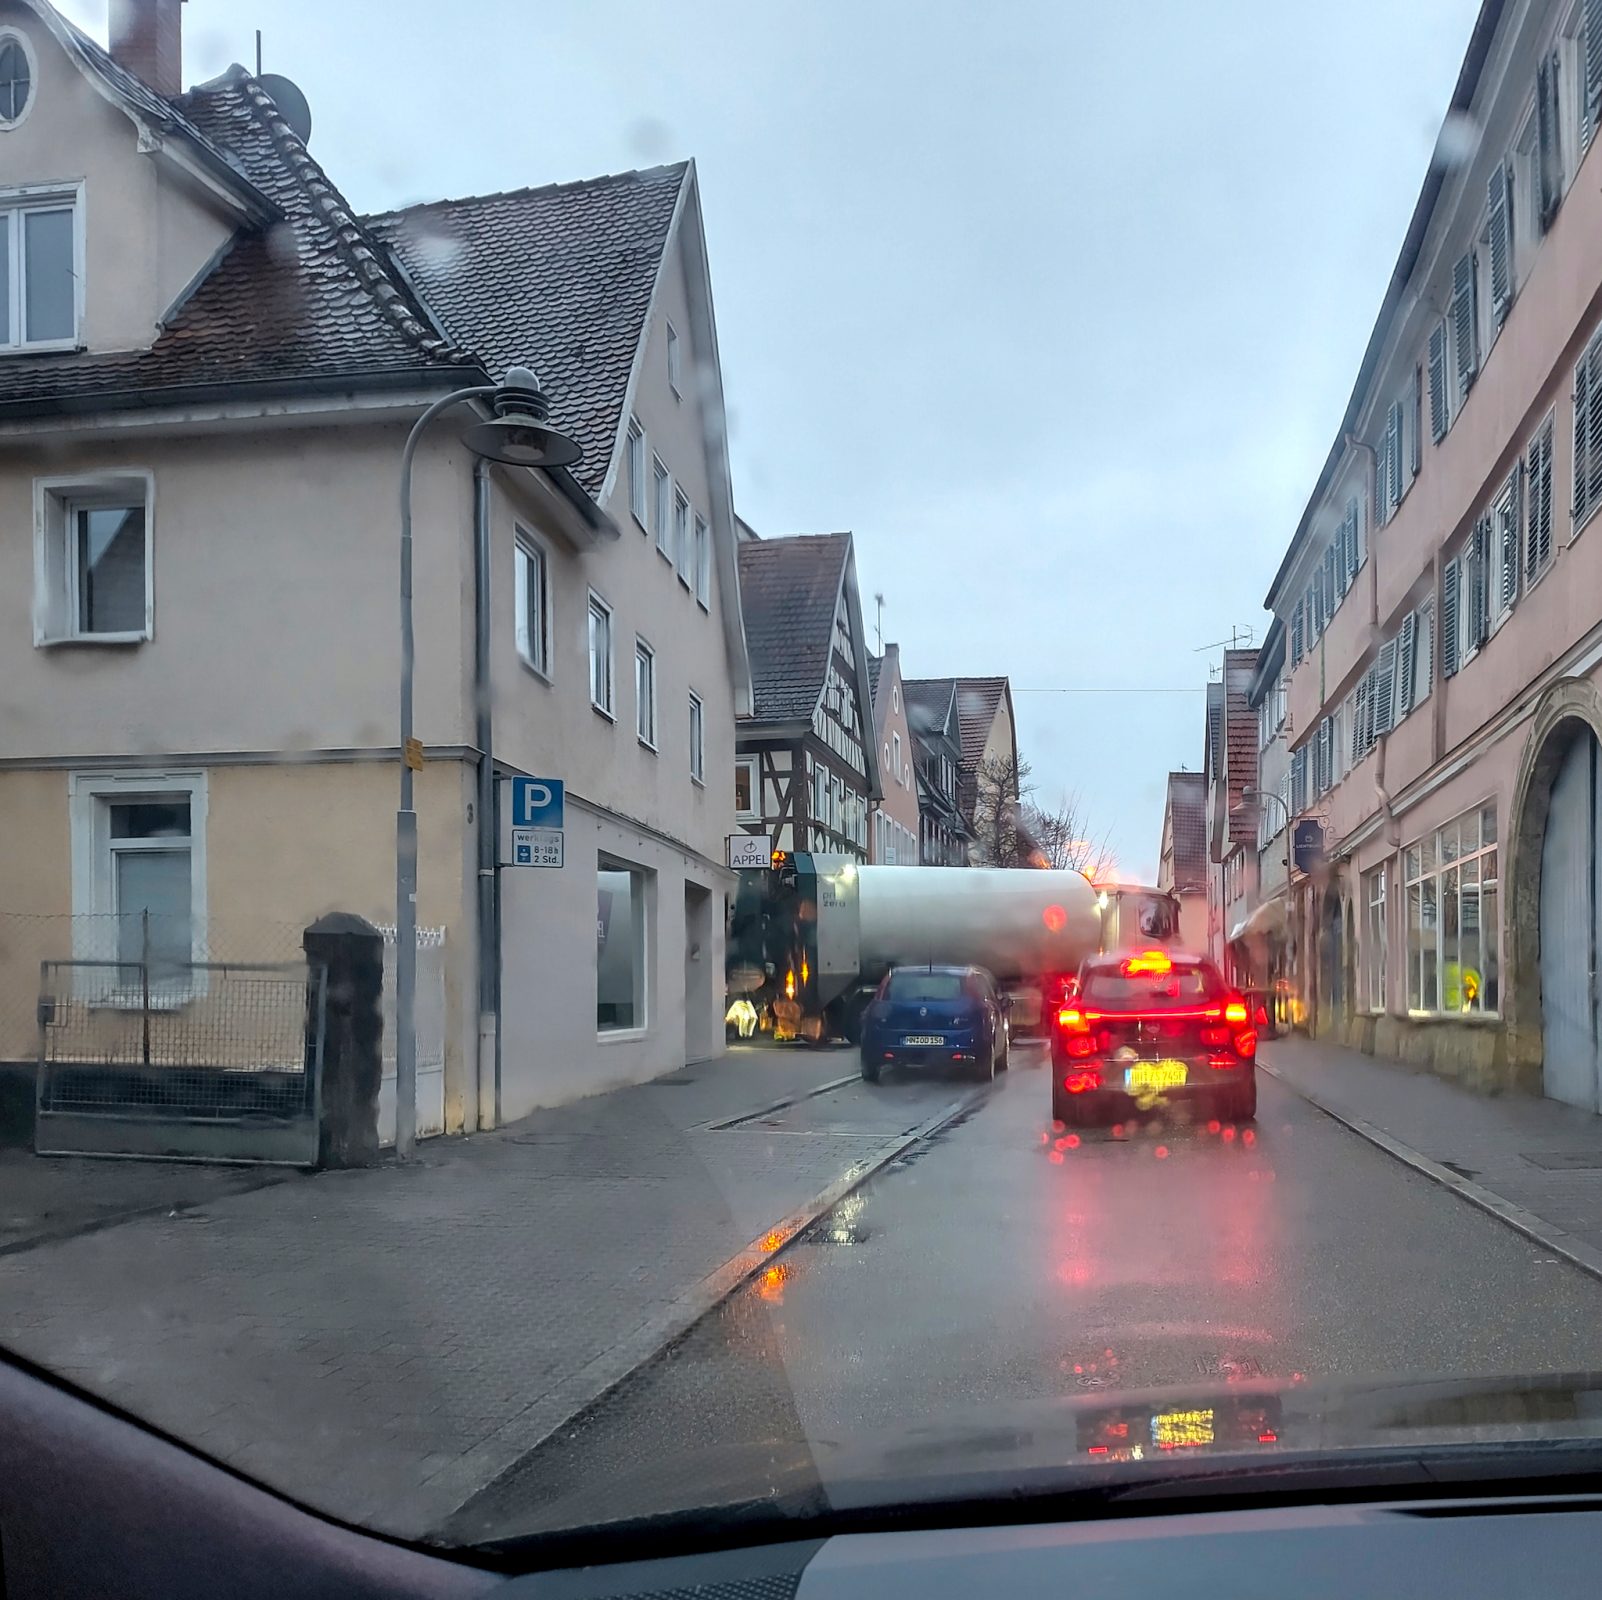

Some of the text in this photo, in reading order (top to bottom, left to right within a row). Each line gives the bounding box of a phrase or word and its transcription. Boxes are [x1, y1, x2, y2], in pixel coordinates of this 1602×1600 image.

[524, 783, 552, 820] P
[517, 834, 560, 844] werkgs
[534, 855, 560, 864] 2 Std.
[732, 854, 769, 865] APPEL
